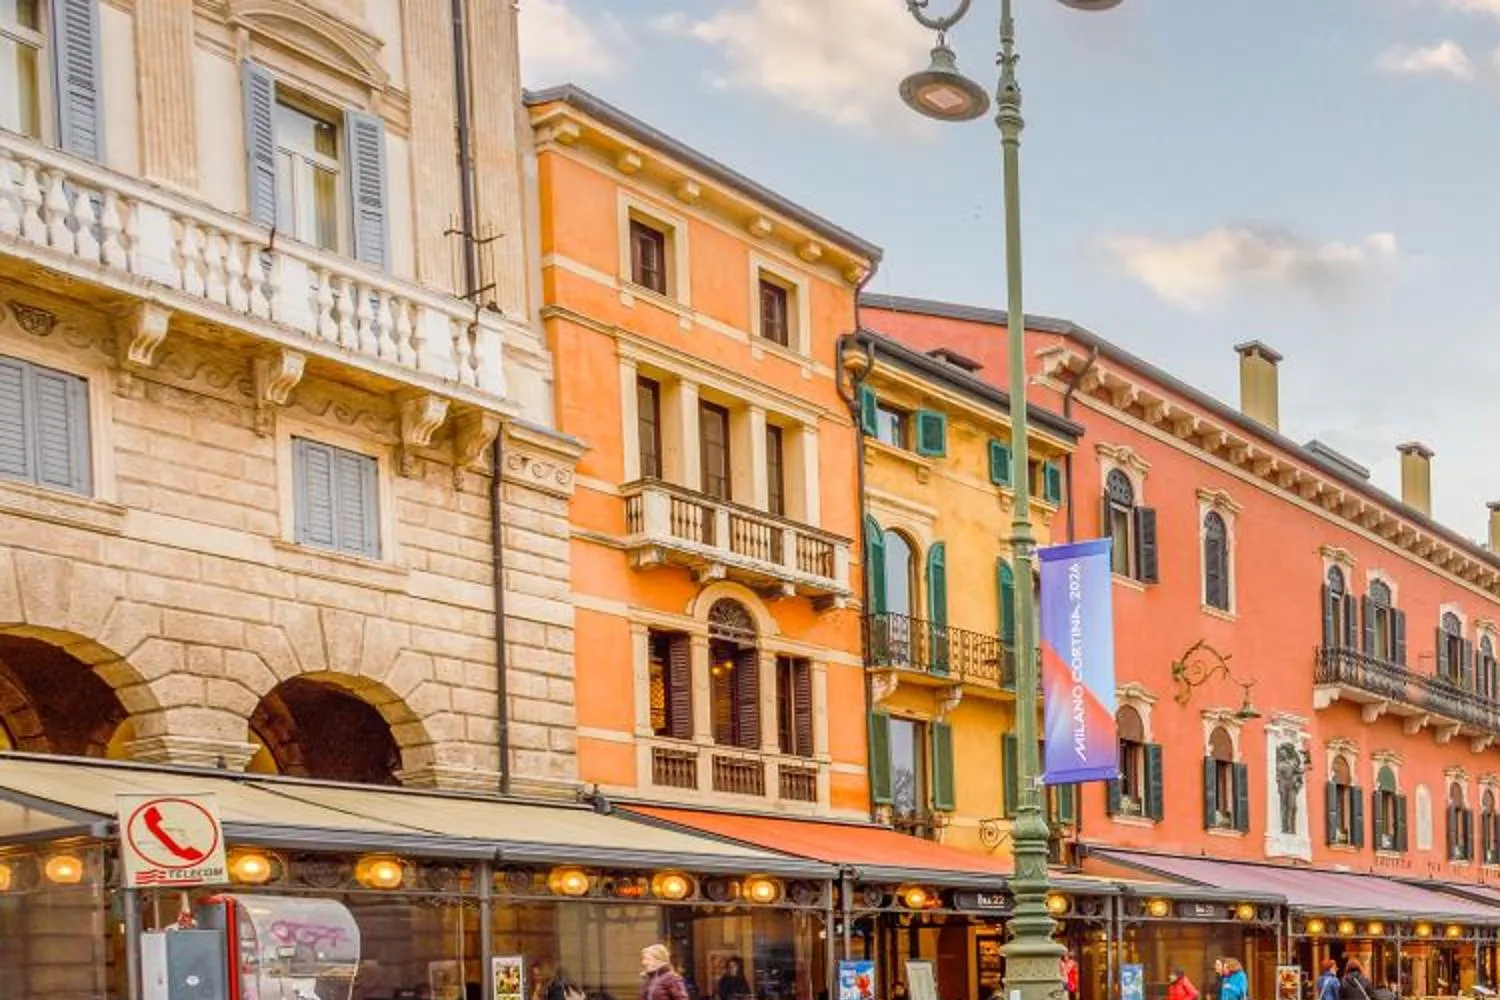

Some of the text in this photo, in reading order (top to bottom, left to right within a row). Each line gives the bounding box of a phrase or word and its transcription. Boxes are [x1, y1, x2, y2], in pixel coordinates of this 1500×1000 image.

[1068, 563, 1087, 763] MILANO CORTINA 2026
[168, 867, 223, 878] TELECOM
